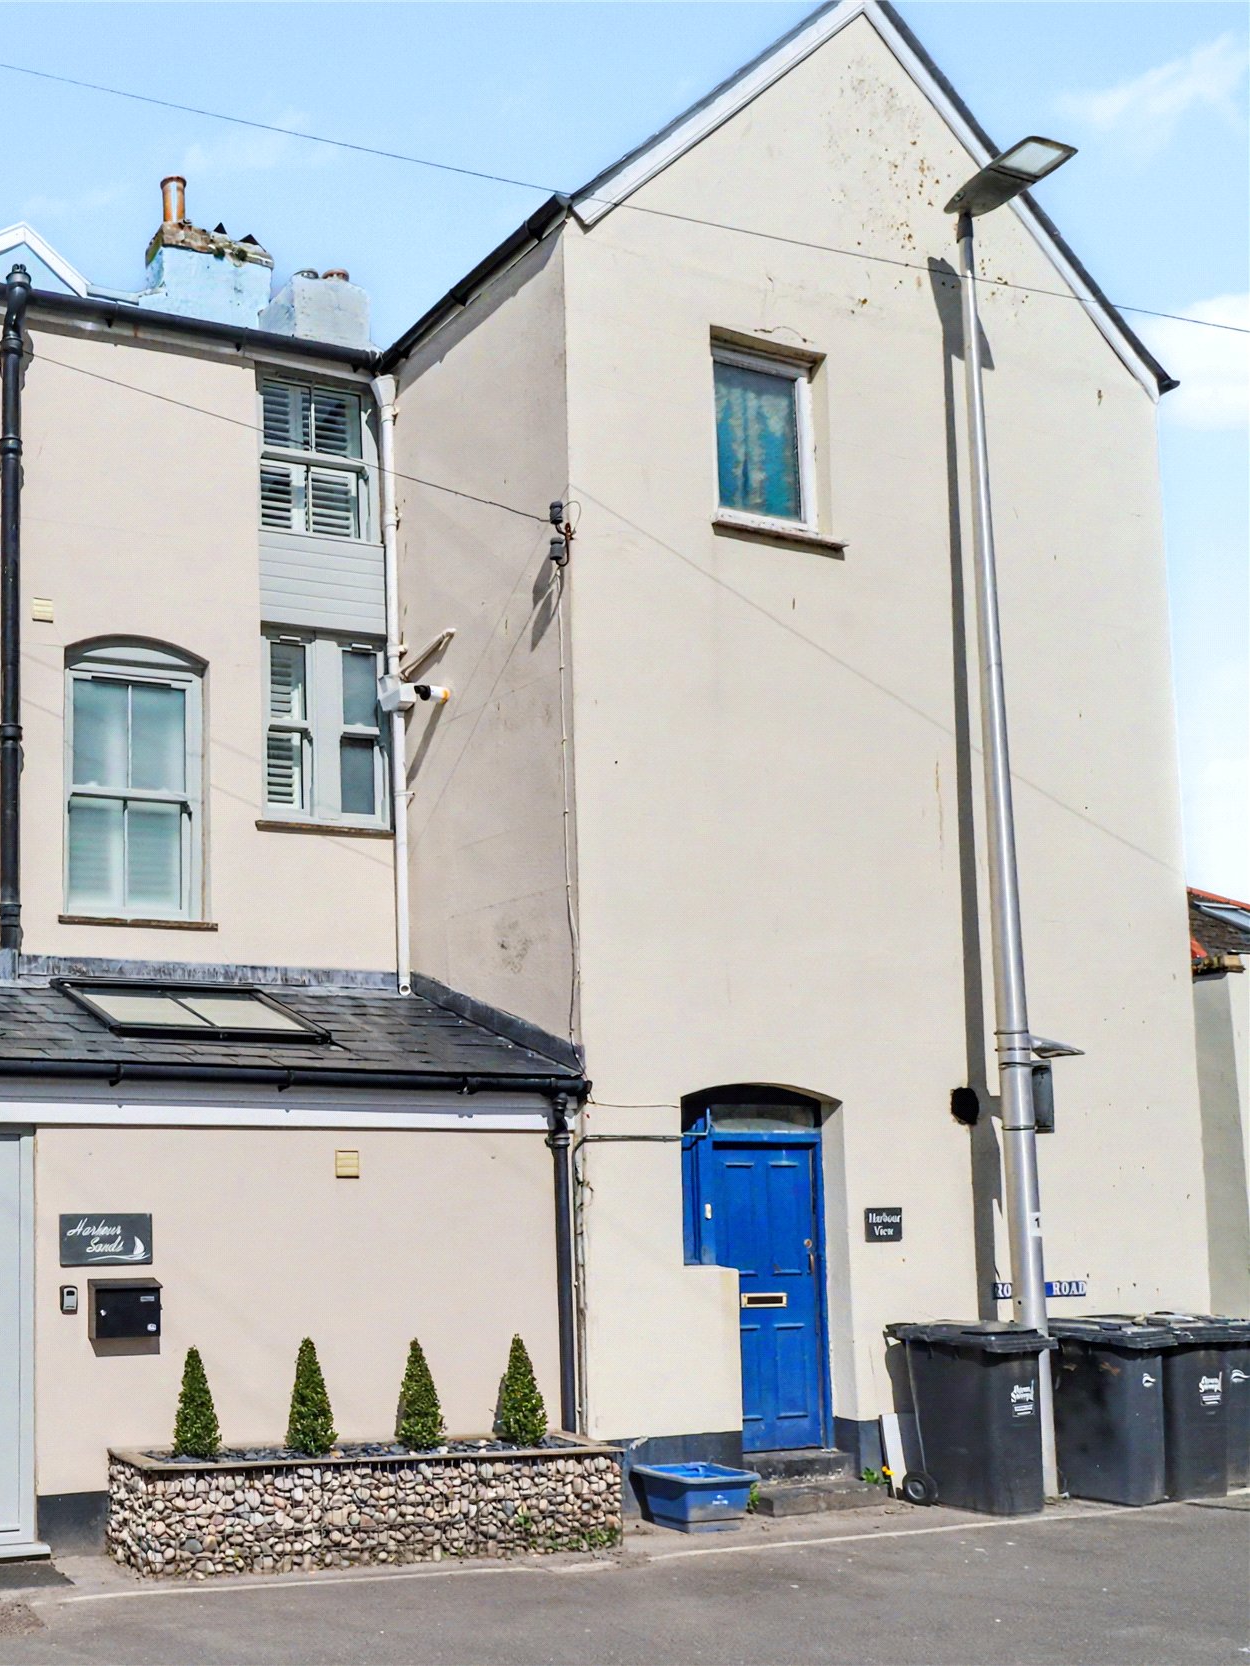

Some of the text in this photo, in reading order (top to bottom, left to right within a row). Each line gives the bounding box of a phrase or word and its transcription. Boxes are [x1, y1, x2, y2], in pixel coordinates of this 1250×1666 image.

[868, 1212, 901, 1223] Harbour
[66, 1217, 122, 1237] Harbour
[873, 1225, 895, 1236] View
[86, 1235, 125, 1253] Sands
[1052, 1281, 1087, 1295] ROAD
